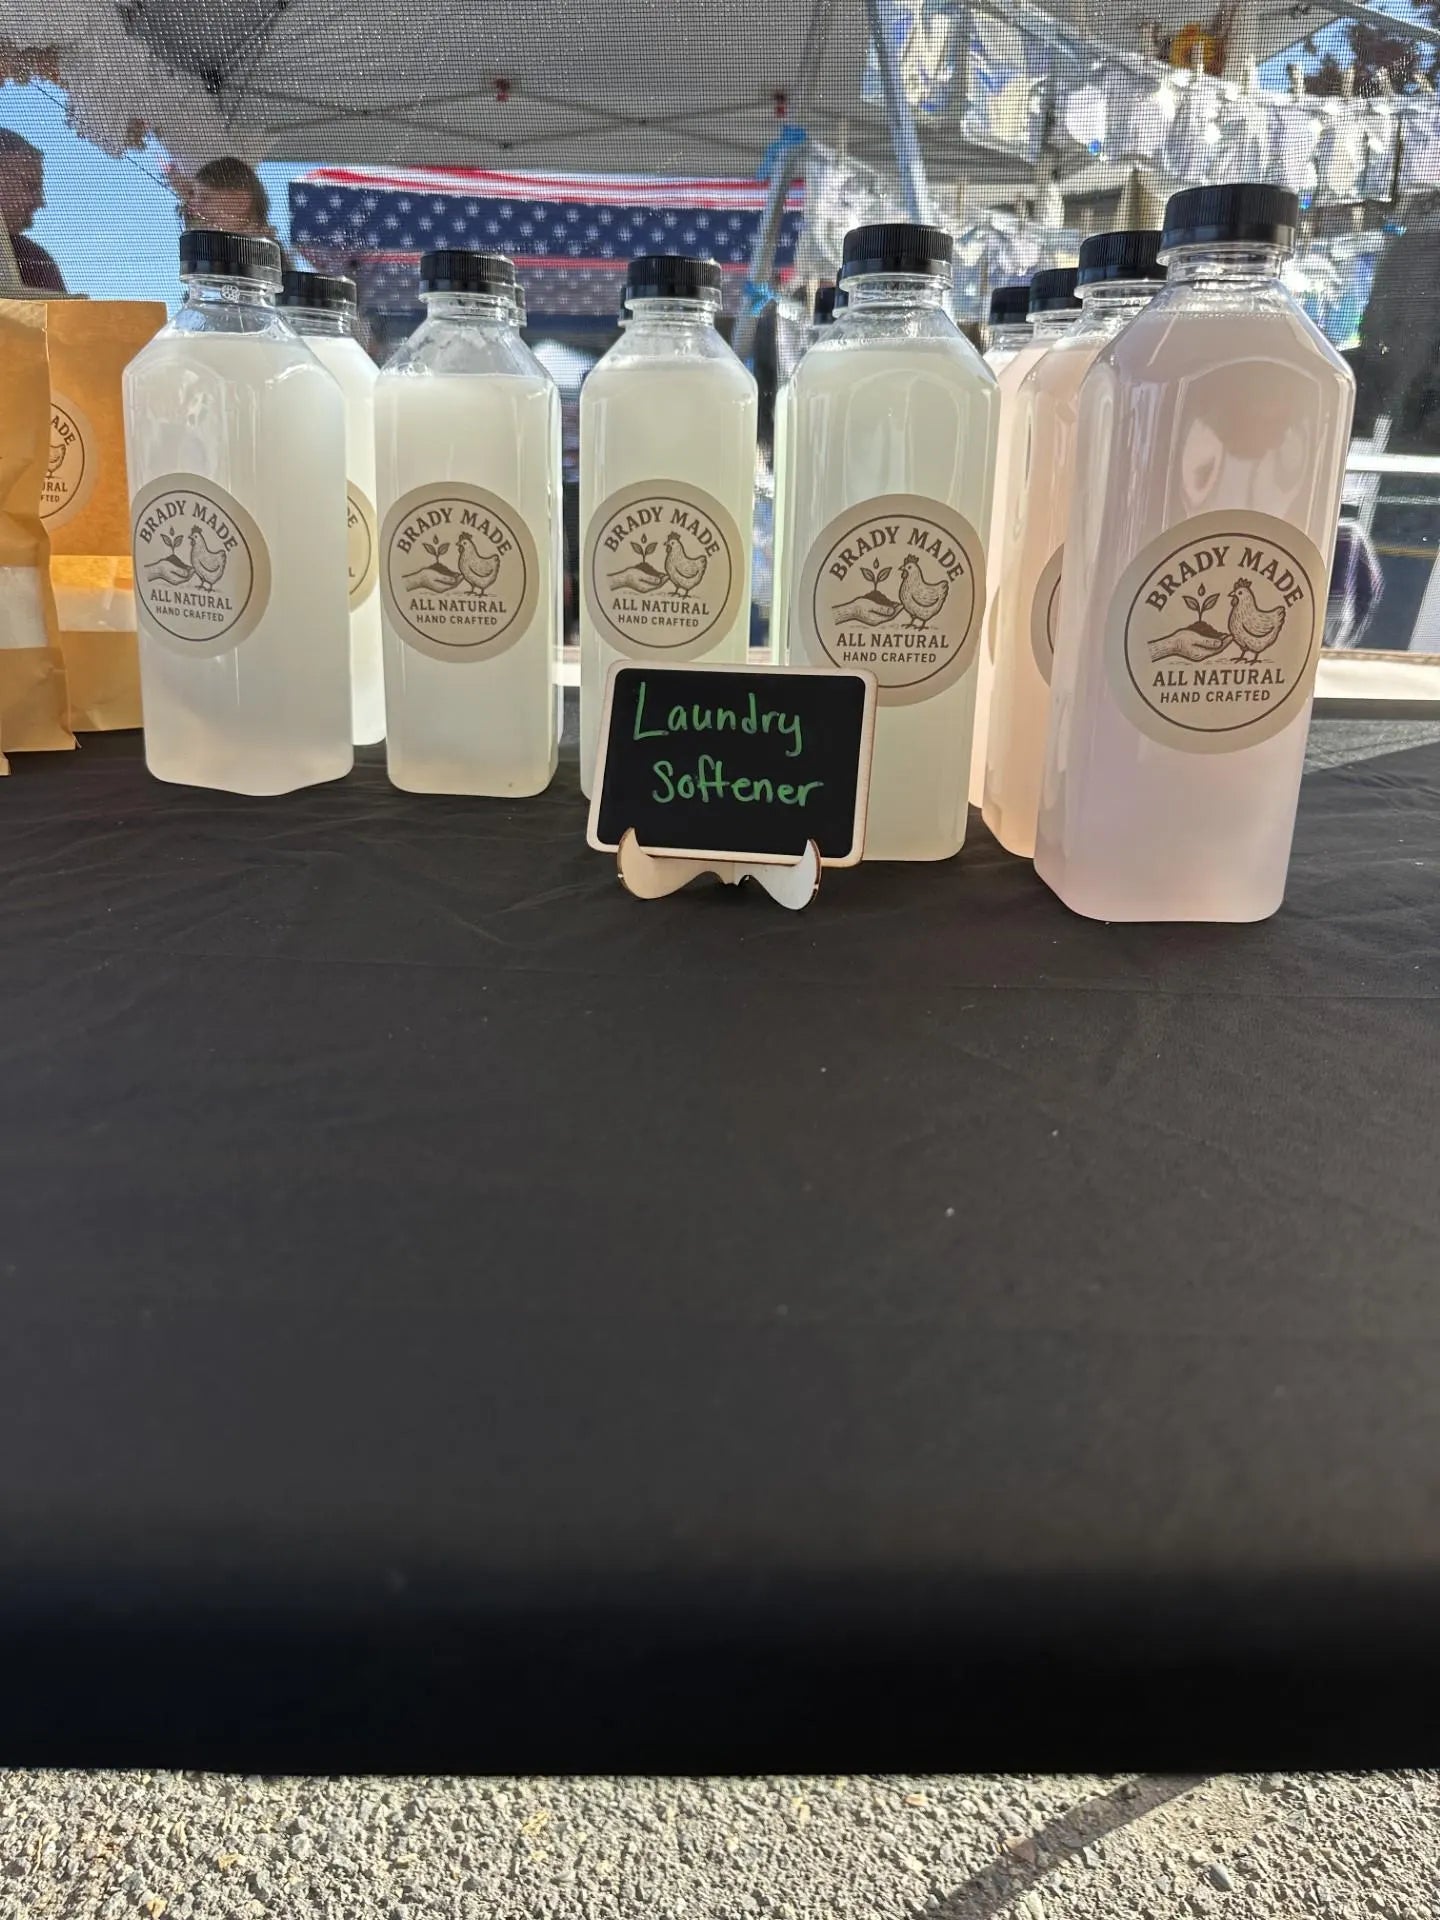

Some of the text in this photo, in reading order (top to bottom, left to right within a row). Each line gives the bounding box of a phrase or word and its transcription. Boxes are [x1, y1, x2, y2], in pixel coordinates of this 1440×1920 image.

[51, 415, 76, 446] ADE
[40, 494, 60, 503] FTED
[139, 500, 239, 552] BRADY MADE
[396, 507, 453, 555] BRADY
[460, 508, 513, 556] MADE
[604, 506, 720, 557] BRADY MADE
[829, 525, 965, 583] BRADY MADE
[1145, 546, 1304, 612] BRADY MADE
[150, 588, 233, 610] ALL NATURAL
[409, 598, 507, 613] ALL NATURAL
[612, 597, 710, 615] ALL NATURAL
[156, 605, 224, 622] HAND CRAFTED
[416, 614, 498, 625] HAND CRAFTED
[618, 614, 699, 627] HAND CRAFTED
[836, 632, 949, 649] ALL NATURAL
[843, 652, 937, 663] HAND CRAFTED
[1152, 668, 1285, 687] ALL NATURAL
[1160, 690, 1271, 703] HAND CRAFTED
[633, 681, 803, 757] Laundry
[652, 754, 824, 807] Softener
